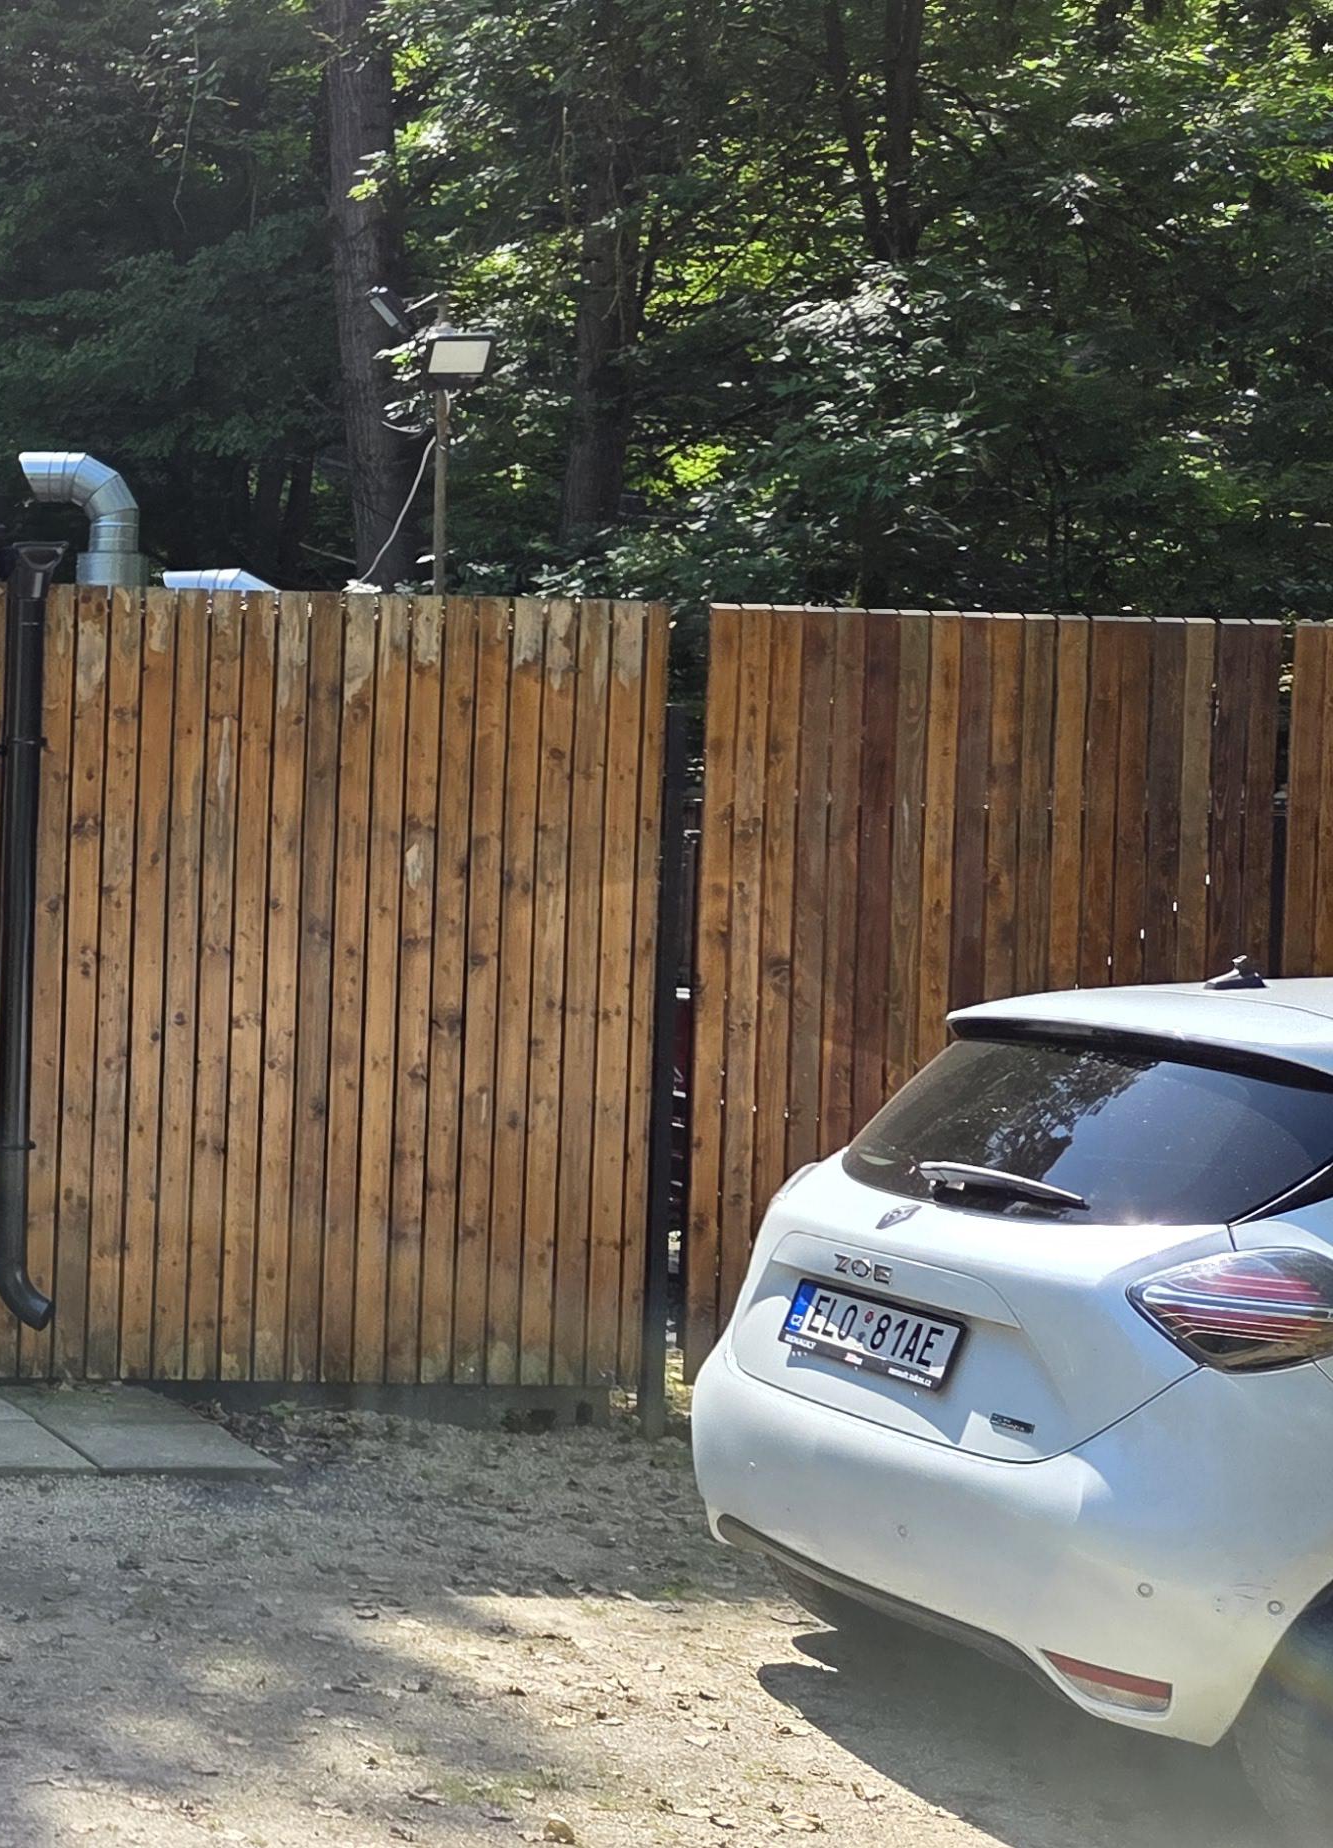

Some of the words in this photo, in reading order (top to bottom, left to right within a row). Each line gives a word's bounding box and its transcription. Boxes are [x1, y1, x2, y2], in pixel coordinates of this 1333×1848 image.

[834, 1253, 894, 1285] ZOE
[790, 1313, 804, 1328] CZ
[869, 1313, 945, 1368] 81AE
